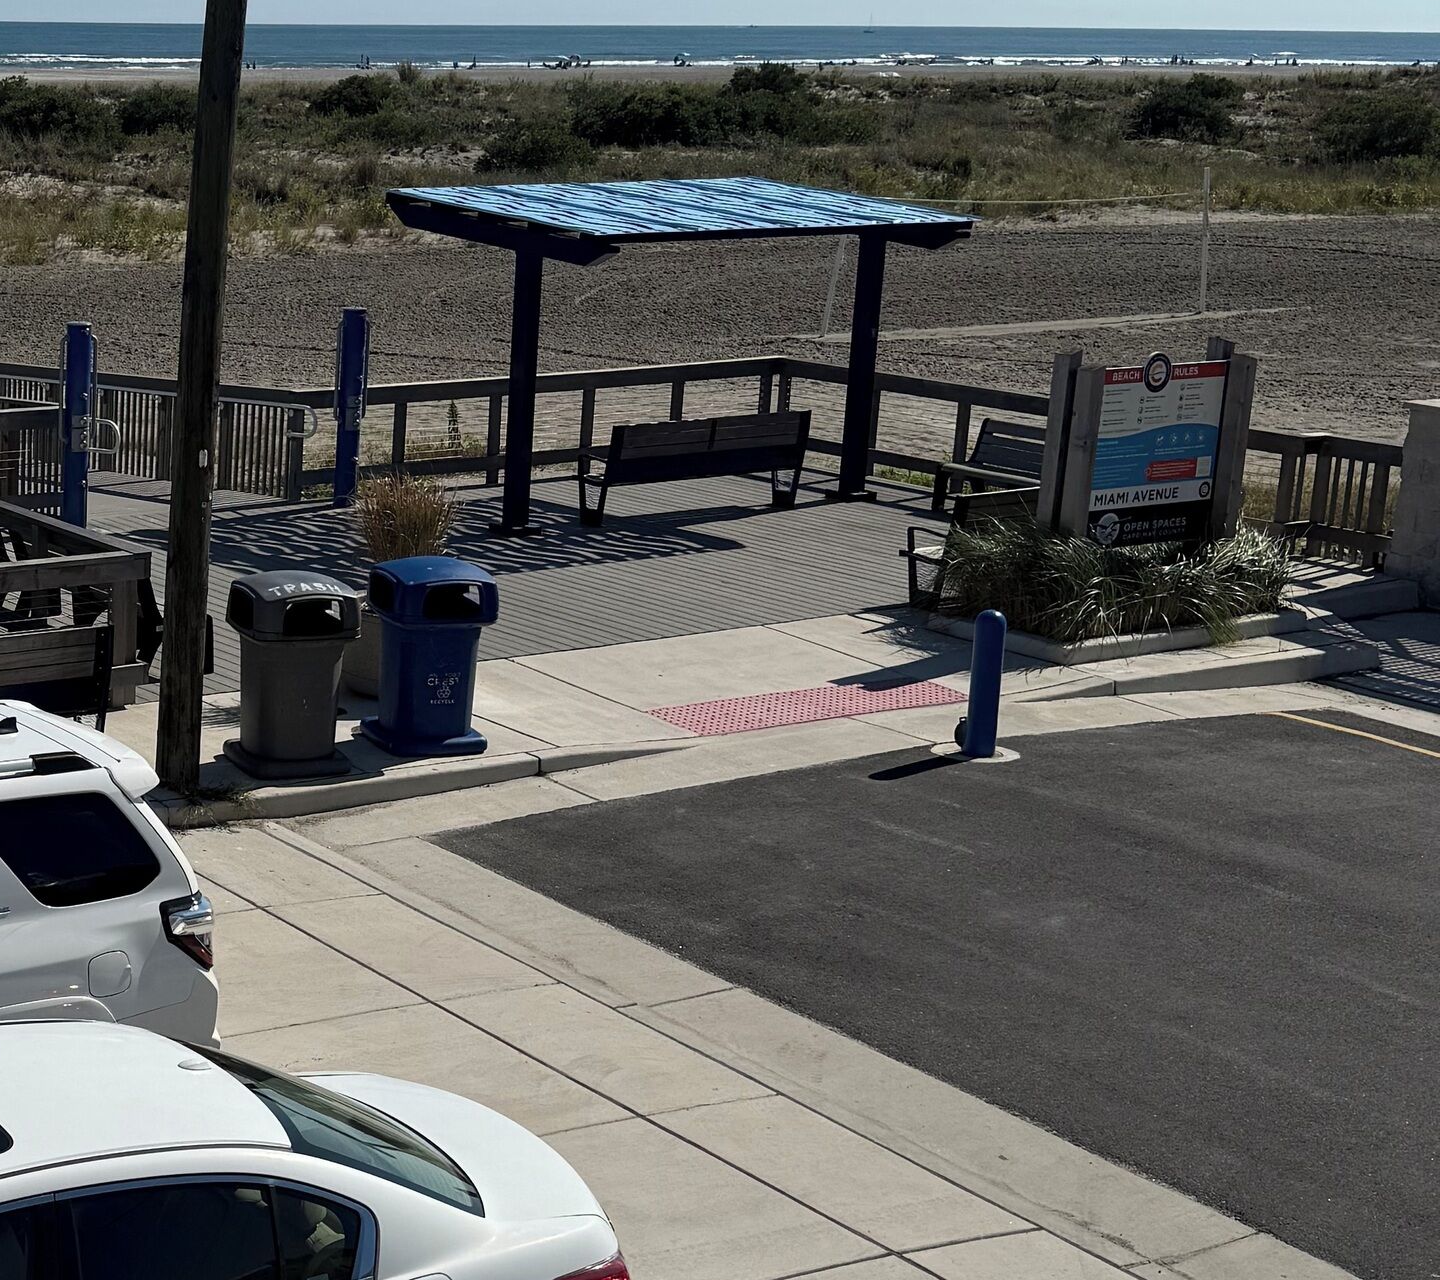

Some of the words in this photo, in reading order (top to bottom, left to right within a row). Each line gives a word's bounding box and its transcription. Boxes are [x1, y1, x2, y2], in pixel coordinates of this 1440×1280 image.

[1112, 371, 1140, 381] BEACH
[1173, 366, 1199, 376] RULES
[1094, 493, 1129, 506] MIAMI
[1132, 486, 1179, 502] AVENUE
[1123, 521, 1150, 532] OPEN
[1152, 517, 1187, 529] SPACES
[268, 582, 342, 596] TRASH
